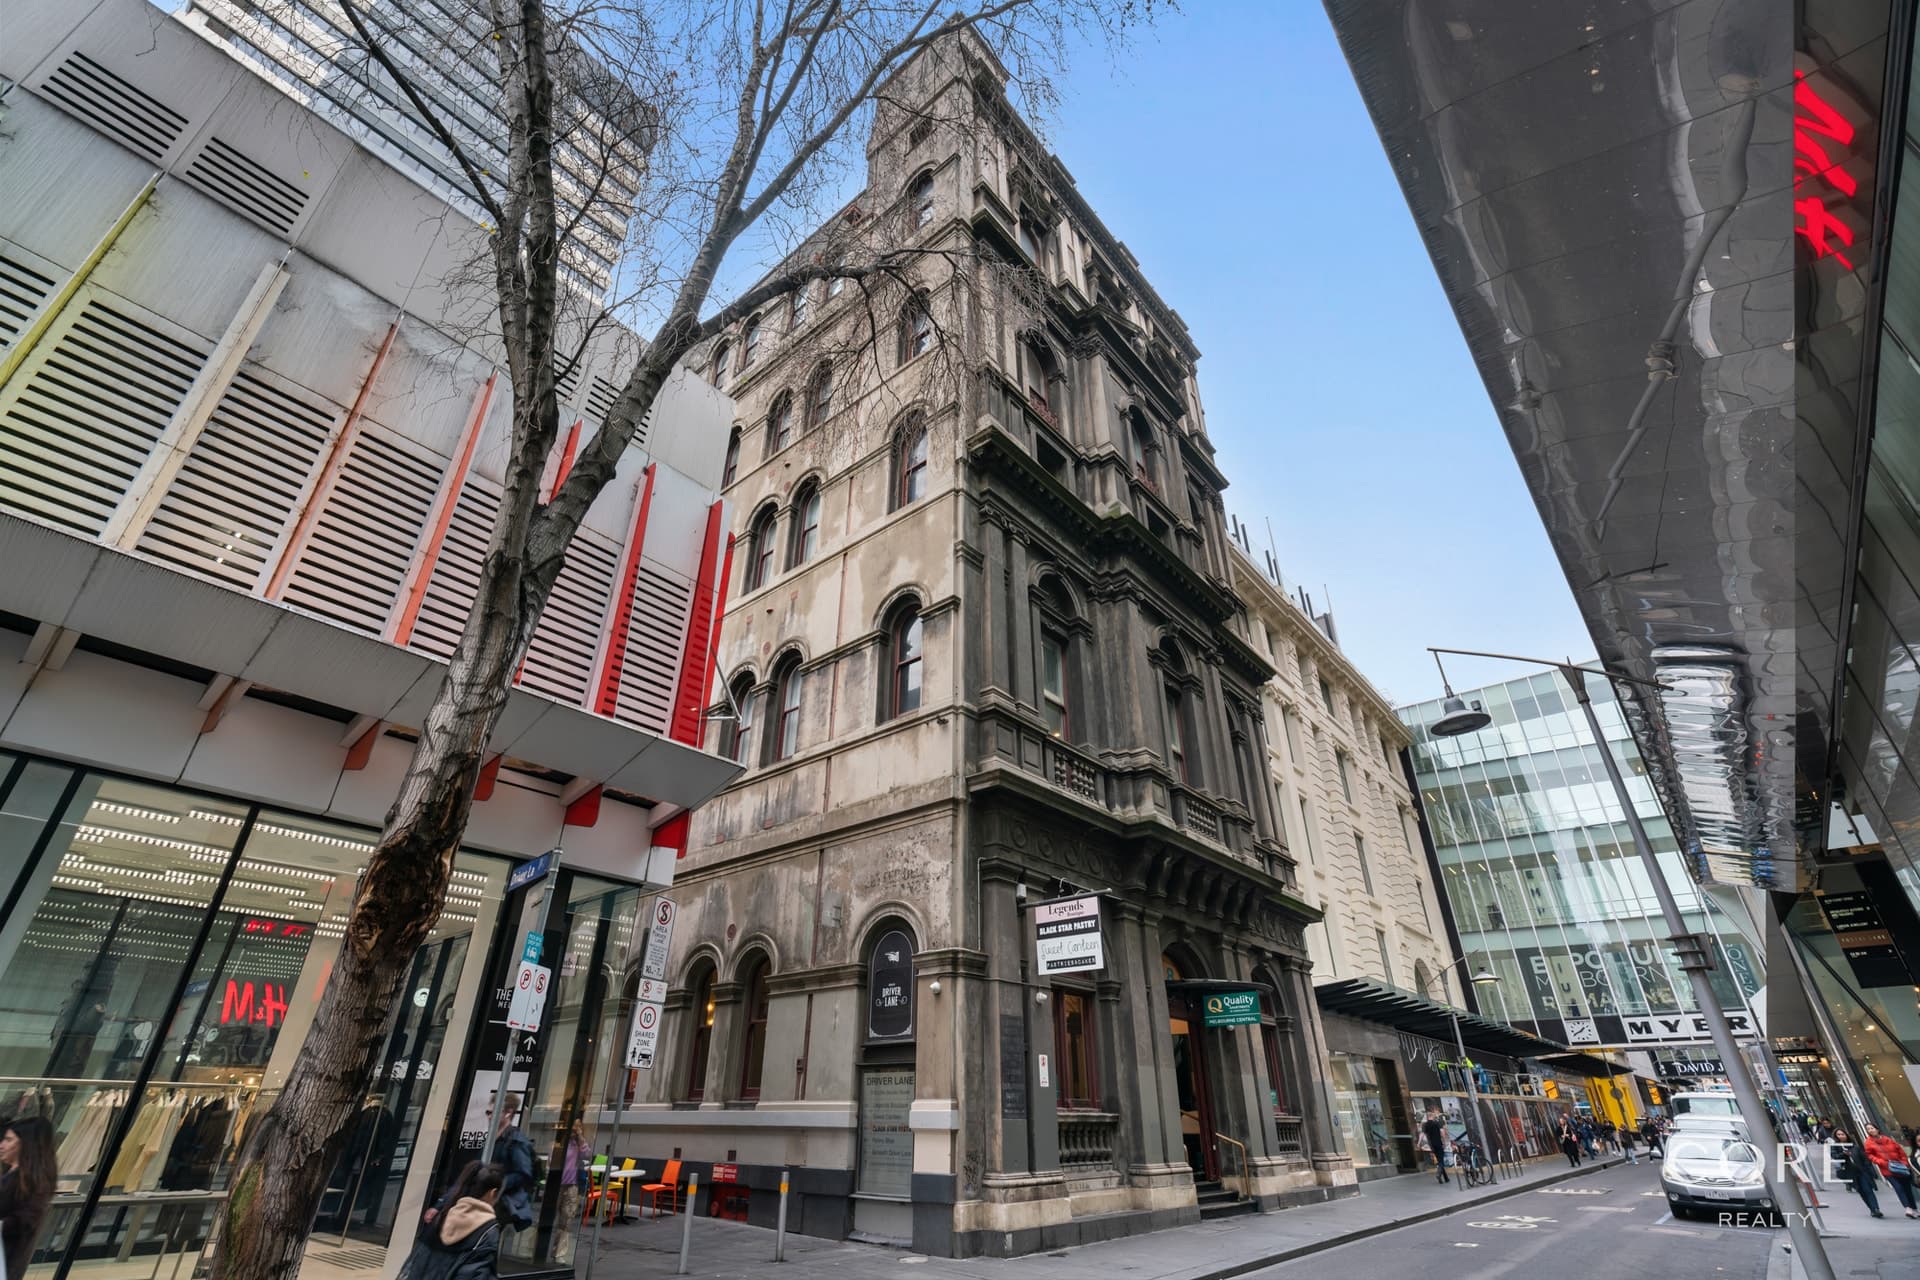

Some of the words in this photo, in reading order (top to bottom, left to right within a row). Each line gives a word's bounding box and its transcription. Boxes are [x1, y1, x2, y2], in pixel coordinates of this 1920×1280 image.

[1048, 900, 1084, 917] Legends
[1039, 925, 1057, 935] BLACK
[1058, 922, 1073, 932] STAR
[1073, 919, 1096, 931] PASTRY
[495, 988, 513, 1001] THE
[882, 986, 902, 998] DRIVER
[884, 996, 898, 1007] LANE
[1223, 995, 1254, 1007] Quality
[1629, 1016, 1750, 1035] MYER
[634, 1030, 656, 1039] SHARED
[636, 1039, 651, 1047] ZONE
[525, 1055, 533, 1063] to
[1677, 1063, 1715, 1074] DAVID
[866, 1076, 893, 1086] DRIVER
[893, 1075, 914, 1086] LANE
[459, 1141, 486, 1150] MELB
